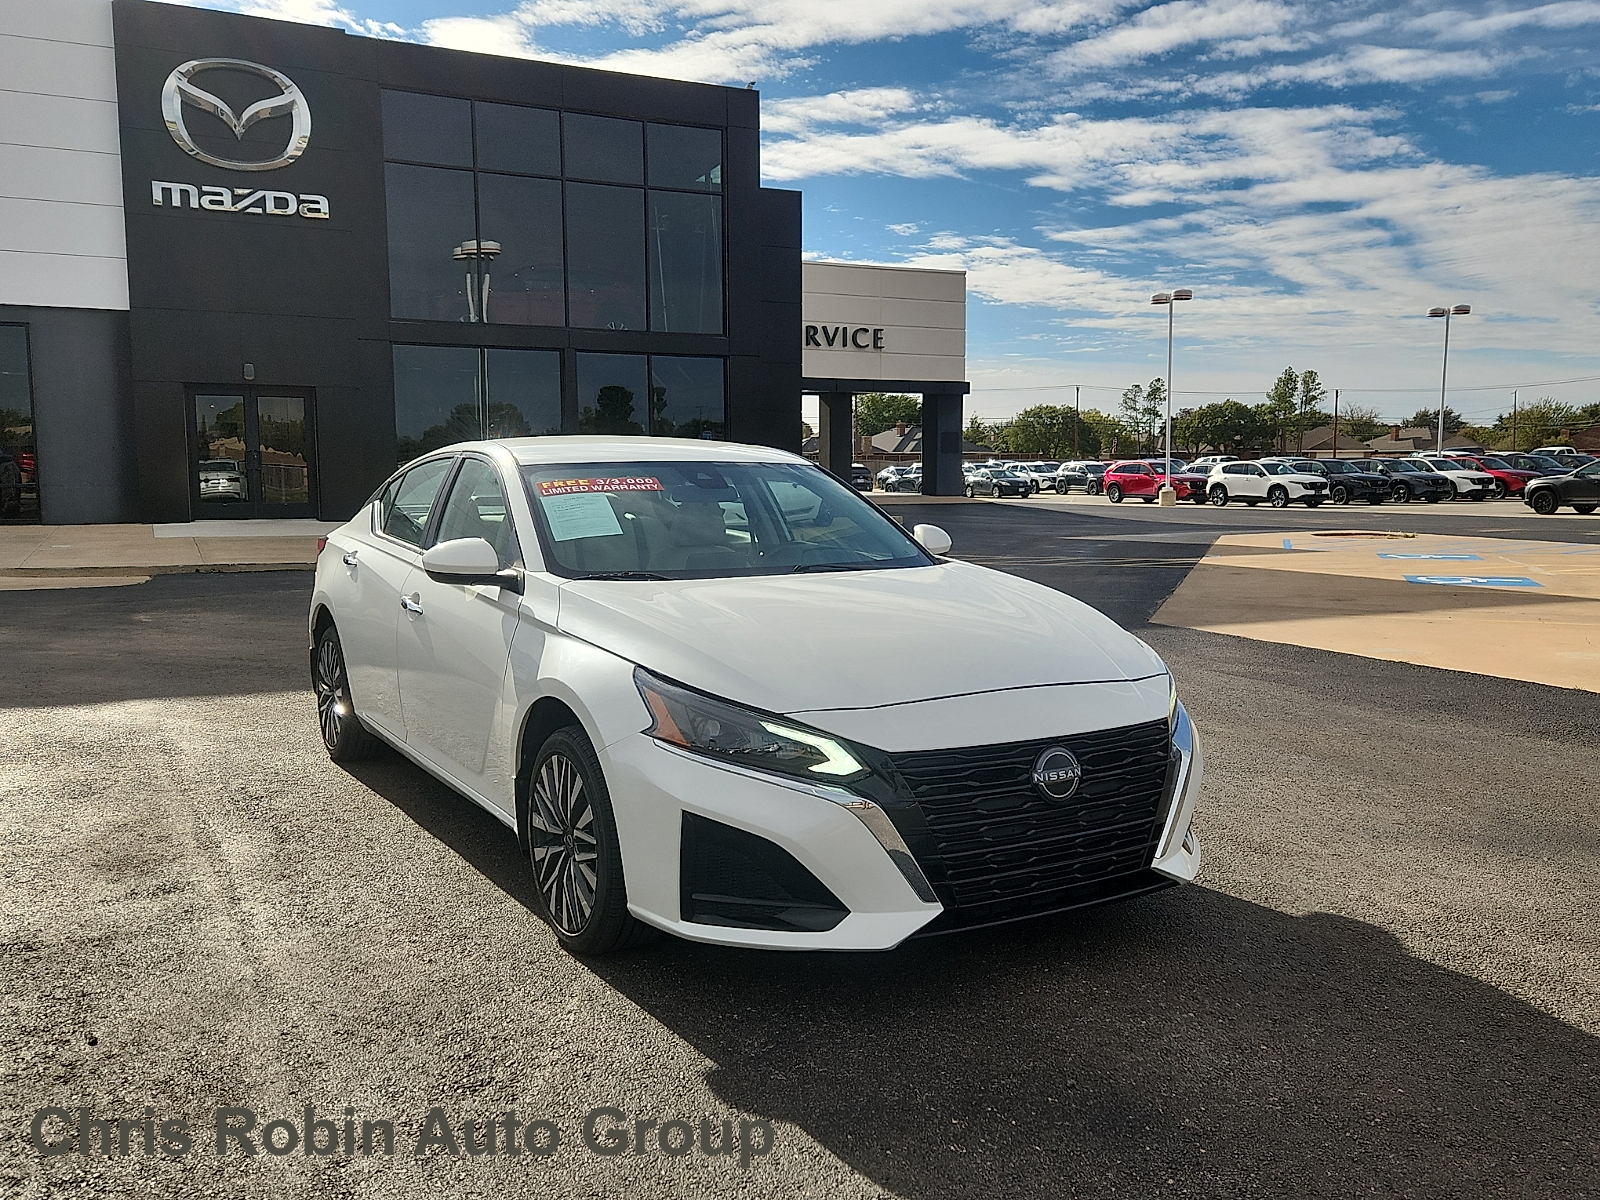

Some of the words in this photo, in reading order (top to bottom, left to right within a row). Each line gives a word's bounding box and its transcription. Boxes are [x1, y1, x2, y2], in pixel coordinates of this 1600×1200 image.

[805, 325, 885, 349] RVICE
[541, 479, 590, 489] FREE
[541, 485, 589, 495] LIMITED
[1034, 767, 1081, 782] NISSAN
